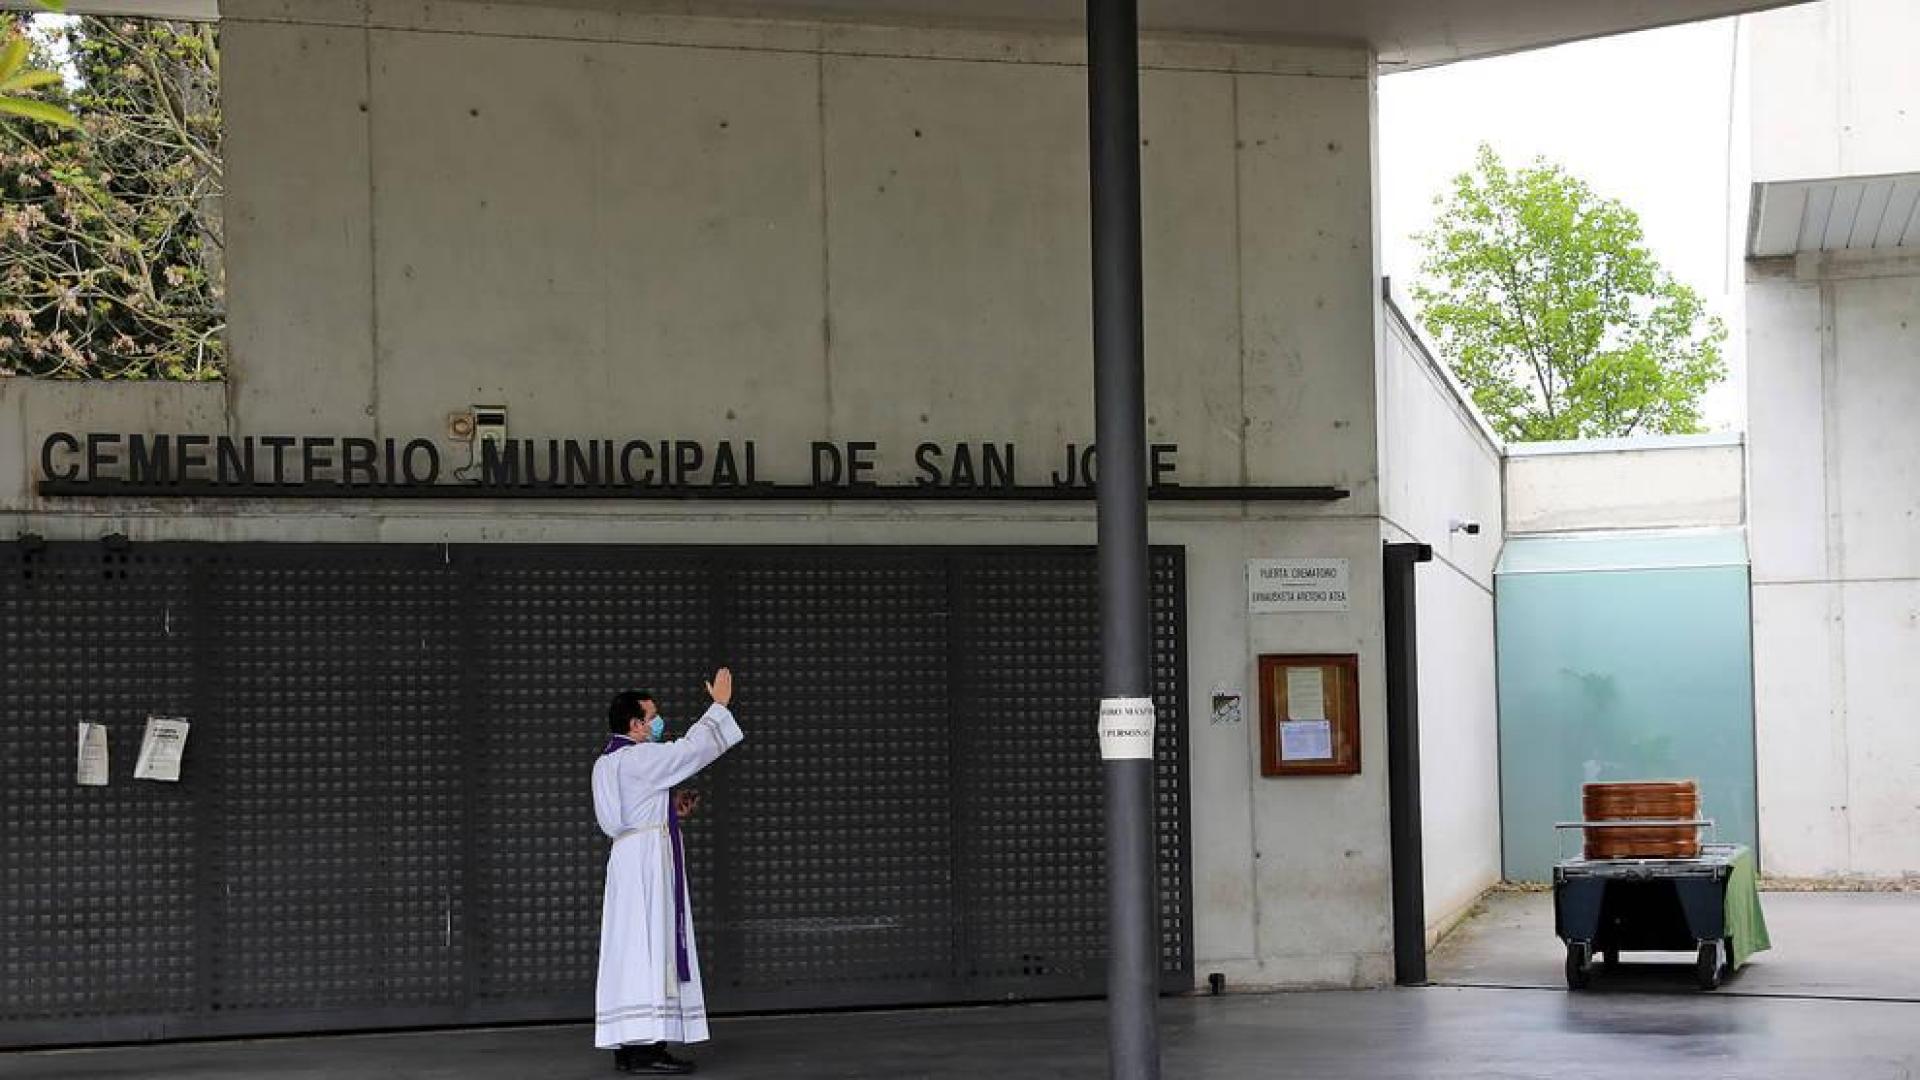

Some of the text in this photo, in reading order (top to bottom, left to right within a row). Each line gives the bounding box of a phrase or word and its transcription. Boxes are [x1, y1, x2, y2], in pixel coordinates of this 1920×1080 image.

[42, 432, 1180, 487] CEMENTERIO MUNICIPAL DE SAN JOE
